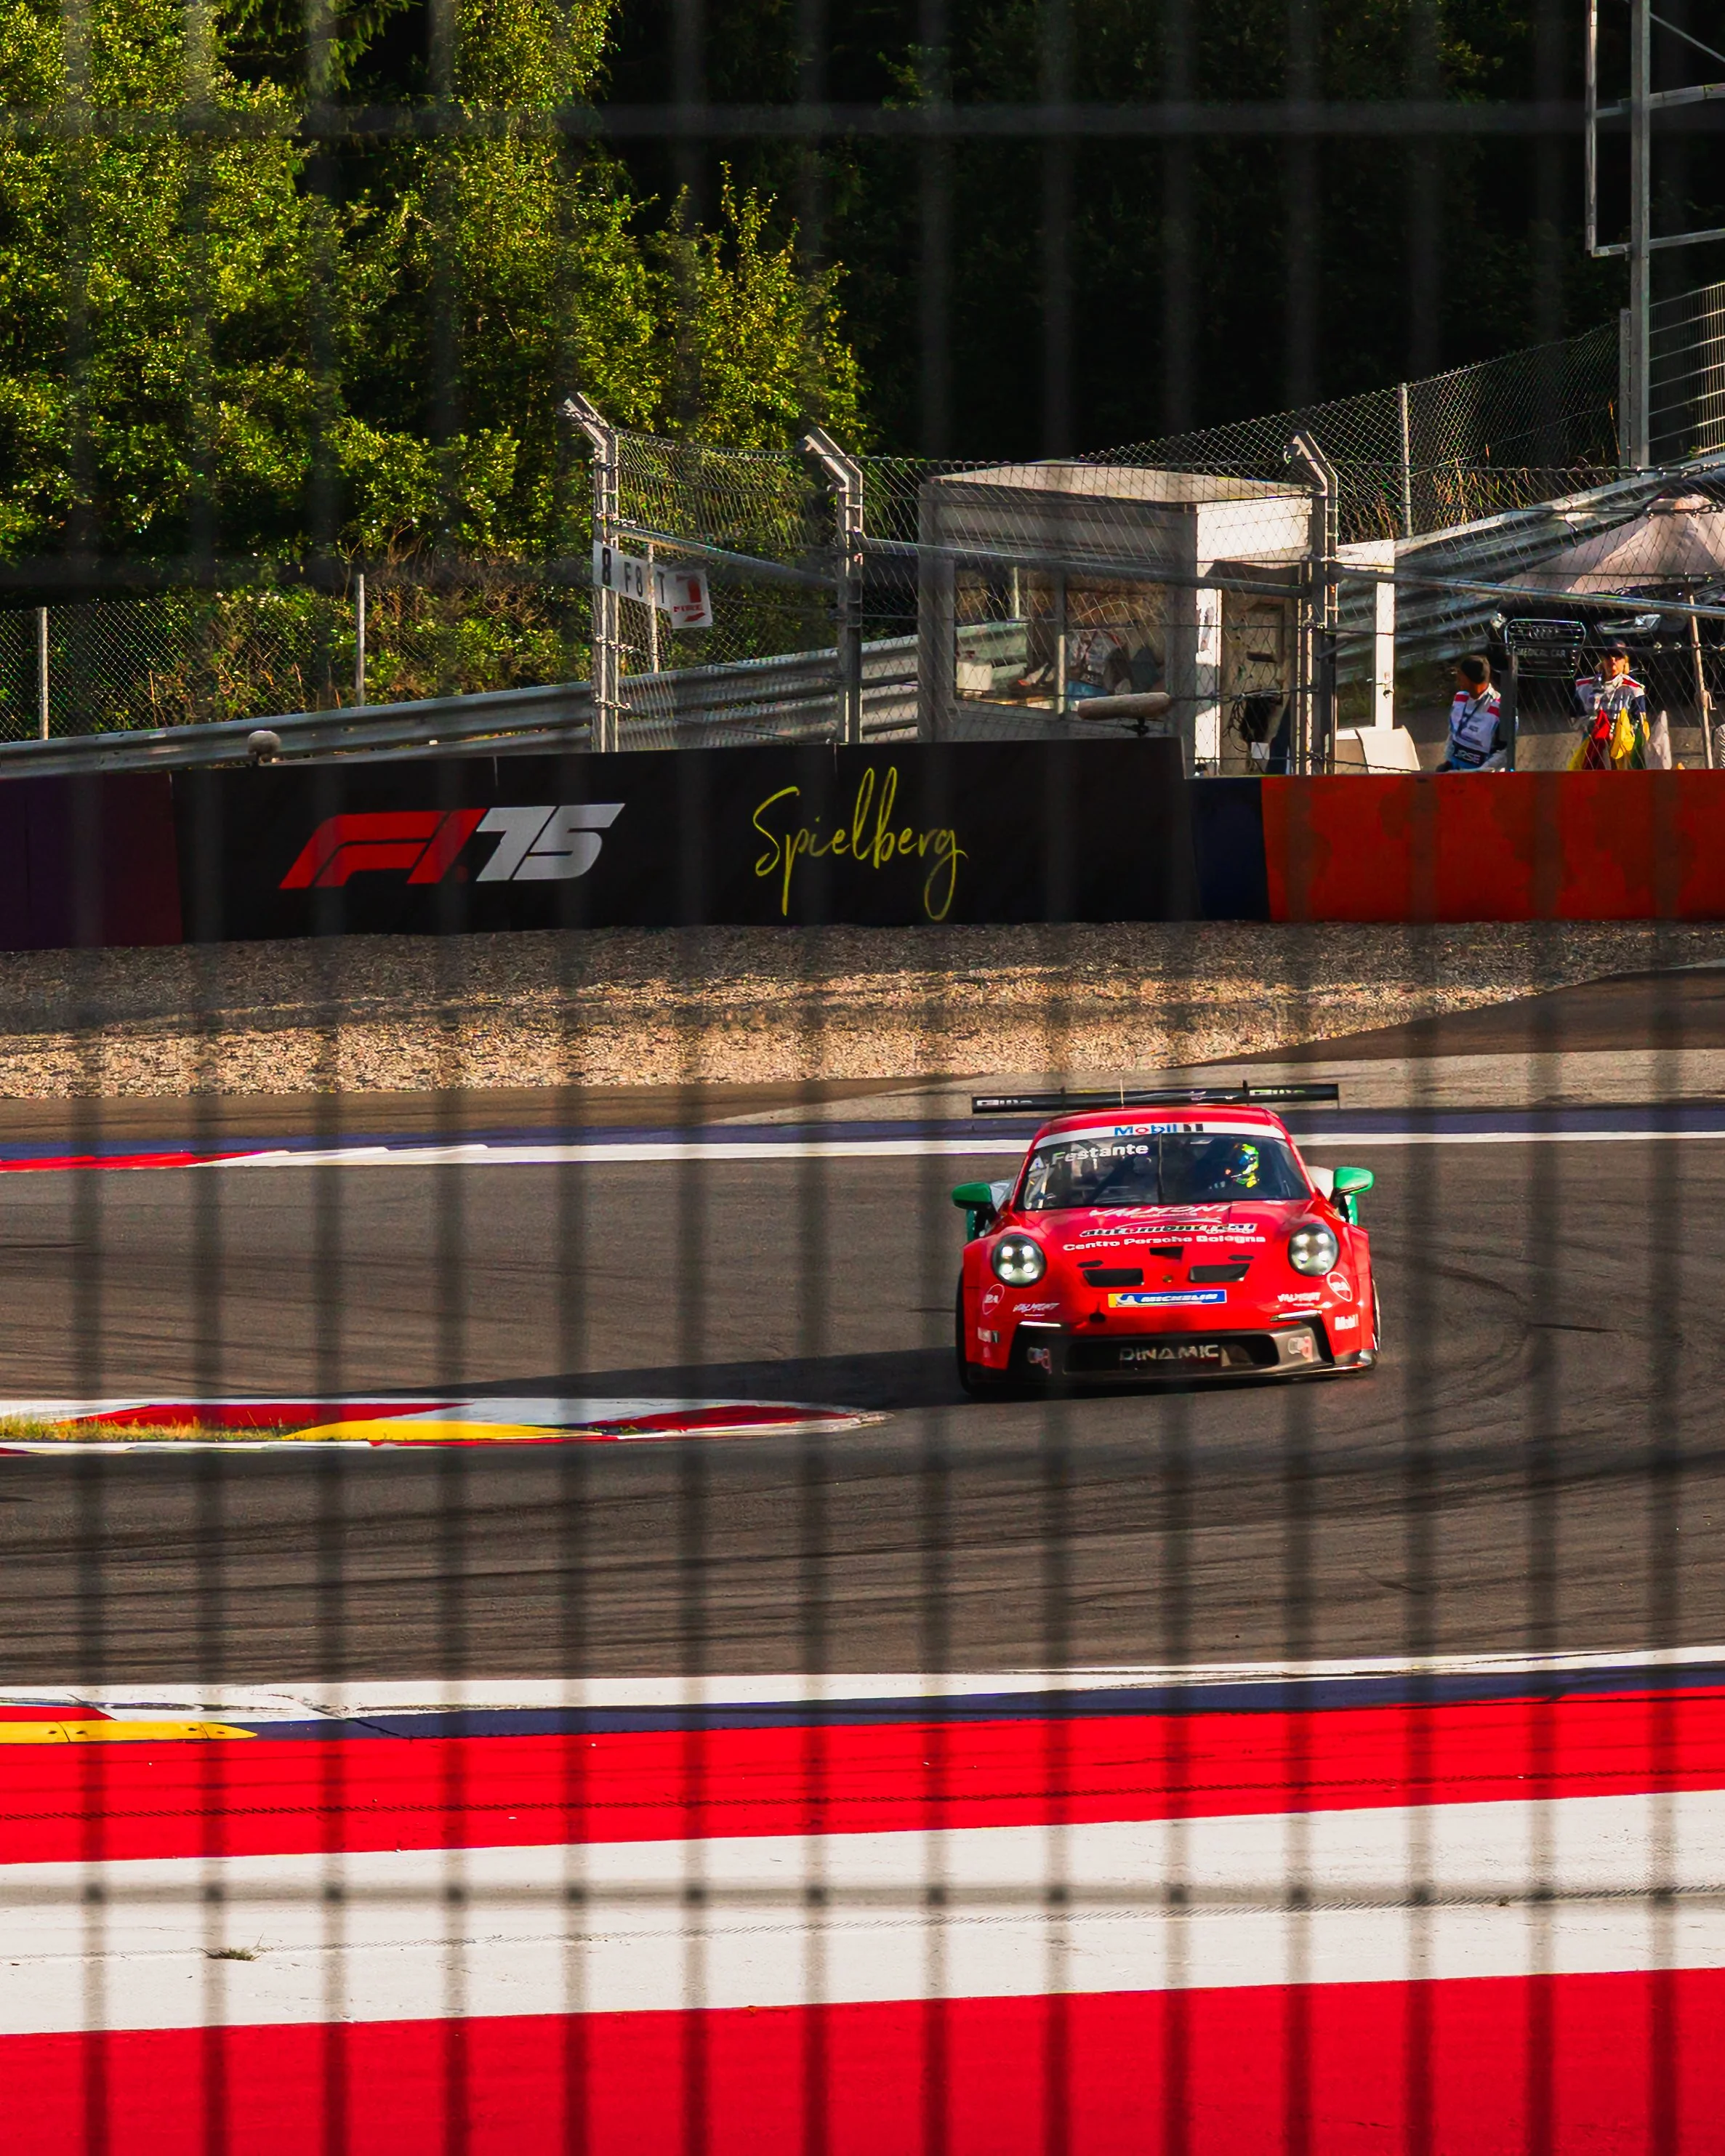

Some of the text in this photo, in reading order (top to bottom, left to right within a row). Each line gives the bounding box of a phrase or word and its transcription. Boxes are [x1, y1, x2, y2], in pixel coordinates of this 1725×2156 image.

[753, 766, 969, 921] Spielberg
[1114, 1124, 1177, 1136] Mobil
[1052, 1143, 1149, 1165] Festante
[1063, 1234, 1266, 1251] Centro Porsche Bologna
[1141, 1293, 1218, 1303] MICHELIN
[1119, 1344, 1220, 1361] DINAMIC
